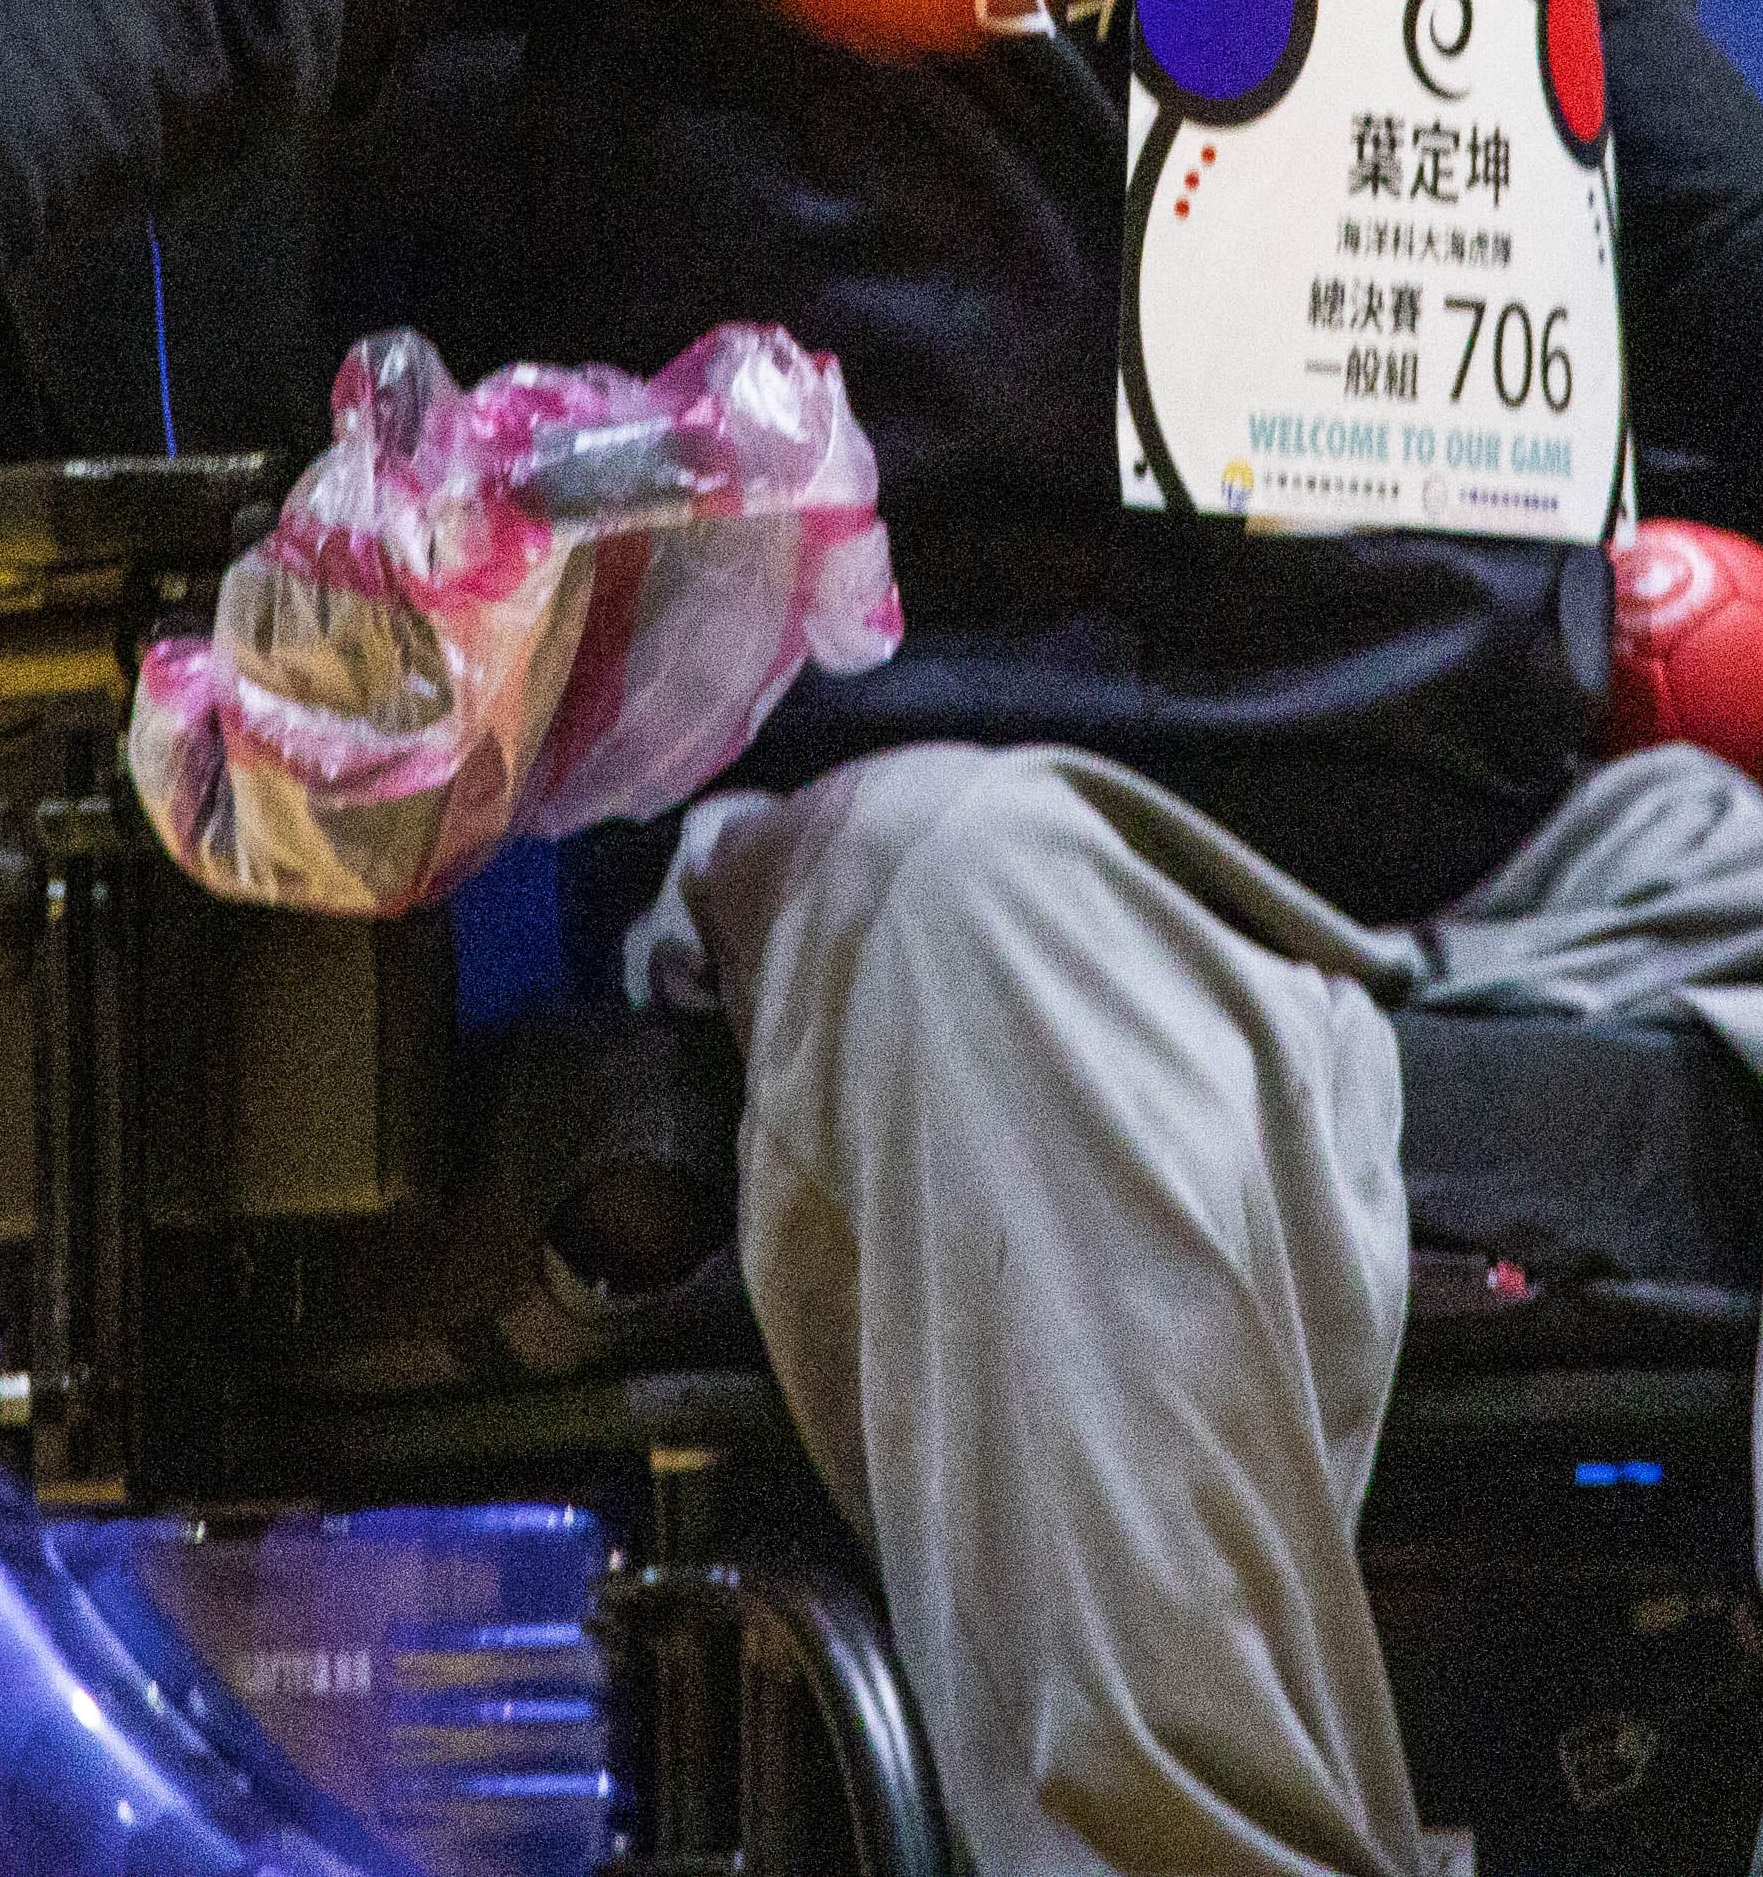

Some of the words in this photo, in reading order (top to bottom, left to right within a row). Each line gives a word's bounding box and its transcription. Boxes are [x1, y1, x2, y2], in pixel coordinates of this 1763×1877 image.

[1348, 110, 1511, 207] 葉定坤
[1307, 277, 1423, 337] 總決賽
[1304, 344, 1418, 401] 一般組
[1444, 294, 1572, 413] 706
[1249, 412, 1389, 459] WELCOME
[1402, 424, 1435, 467] TO
[1445, 429, 1501, 471] OUR
[1510, 434, 1572, 478] GAME
